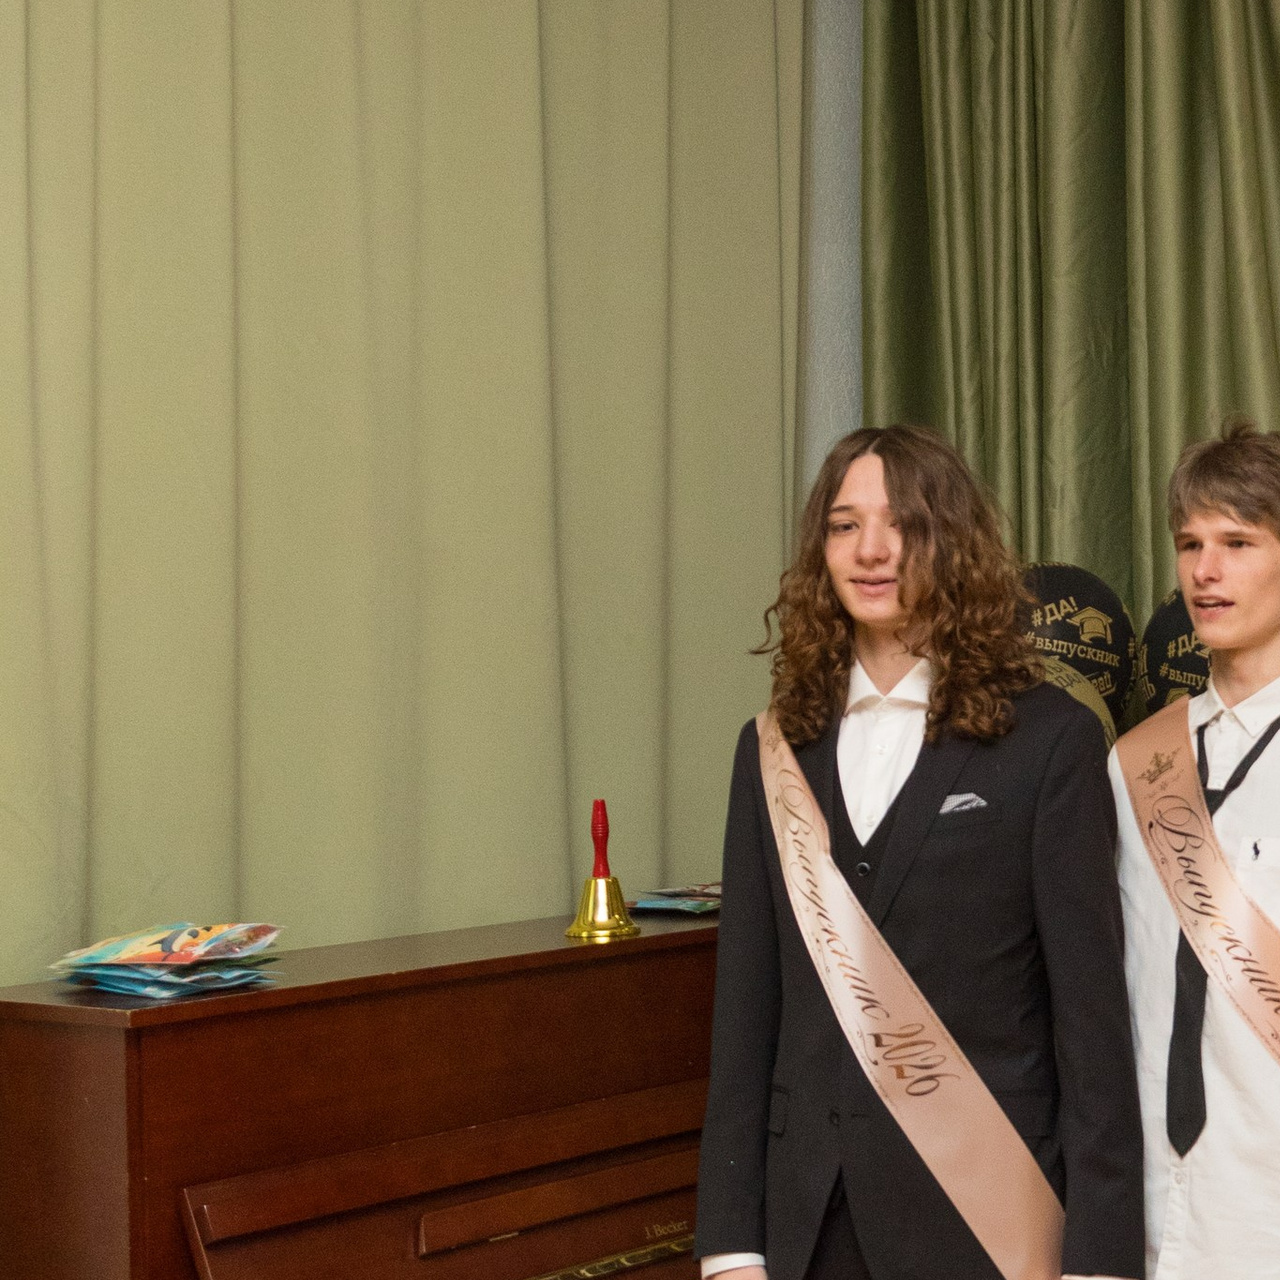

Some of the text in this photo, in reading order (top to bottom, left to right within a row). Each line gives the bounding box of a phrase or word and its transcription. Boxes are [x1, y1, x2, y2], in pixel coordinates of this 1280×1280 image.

[1031, 596, 1078, 628] #ДА!
[1166, 631, 1204, 658] #ДА
[867, 1023, 961, 1096] 2026
